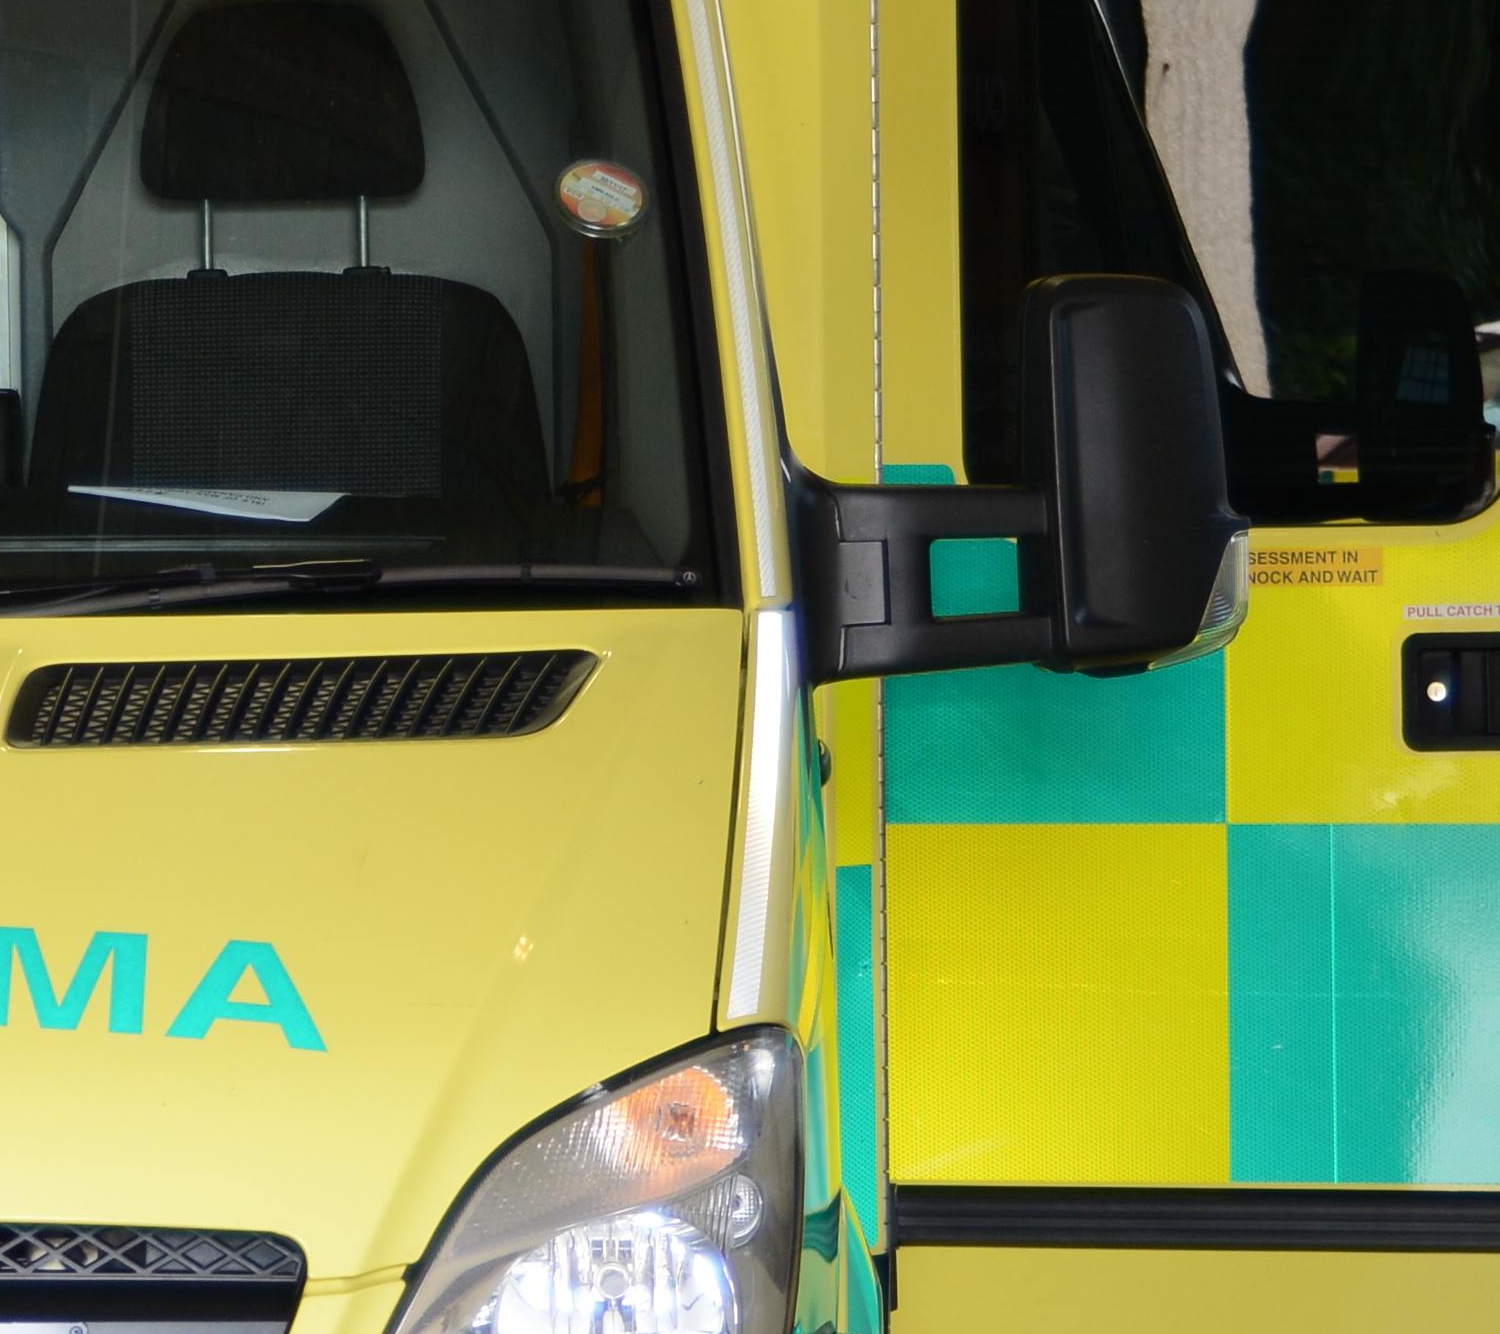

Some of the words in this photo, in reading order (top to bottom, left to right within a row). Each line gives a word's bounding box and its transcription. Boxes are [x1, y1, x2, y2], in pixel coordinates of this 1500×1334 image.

[1342, 550, 1359, 564] IN
[1298, 570, 1334, 584] AND
[1337, 569, 1378, 583] WAIT
[1407, 605, 1443, 618] PULL
[1447, 605, 1493, 617] CATCH
